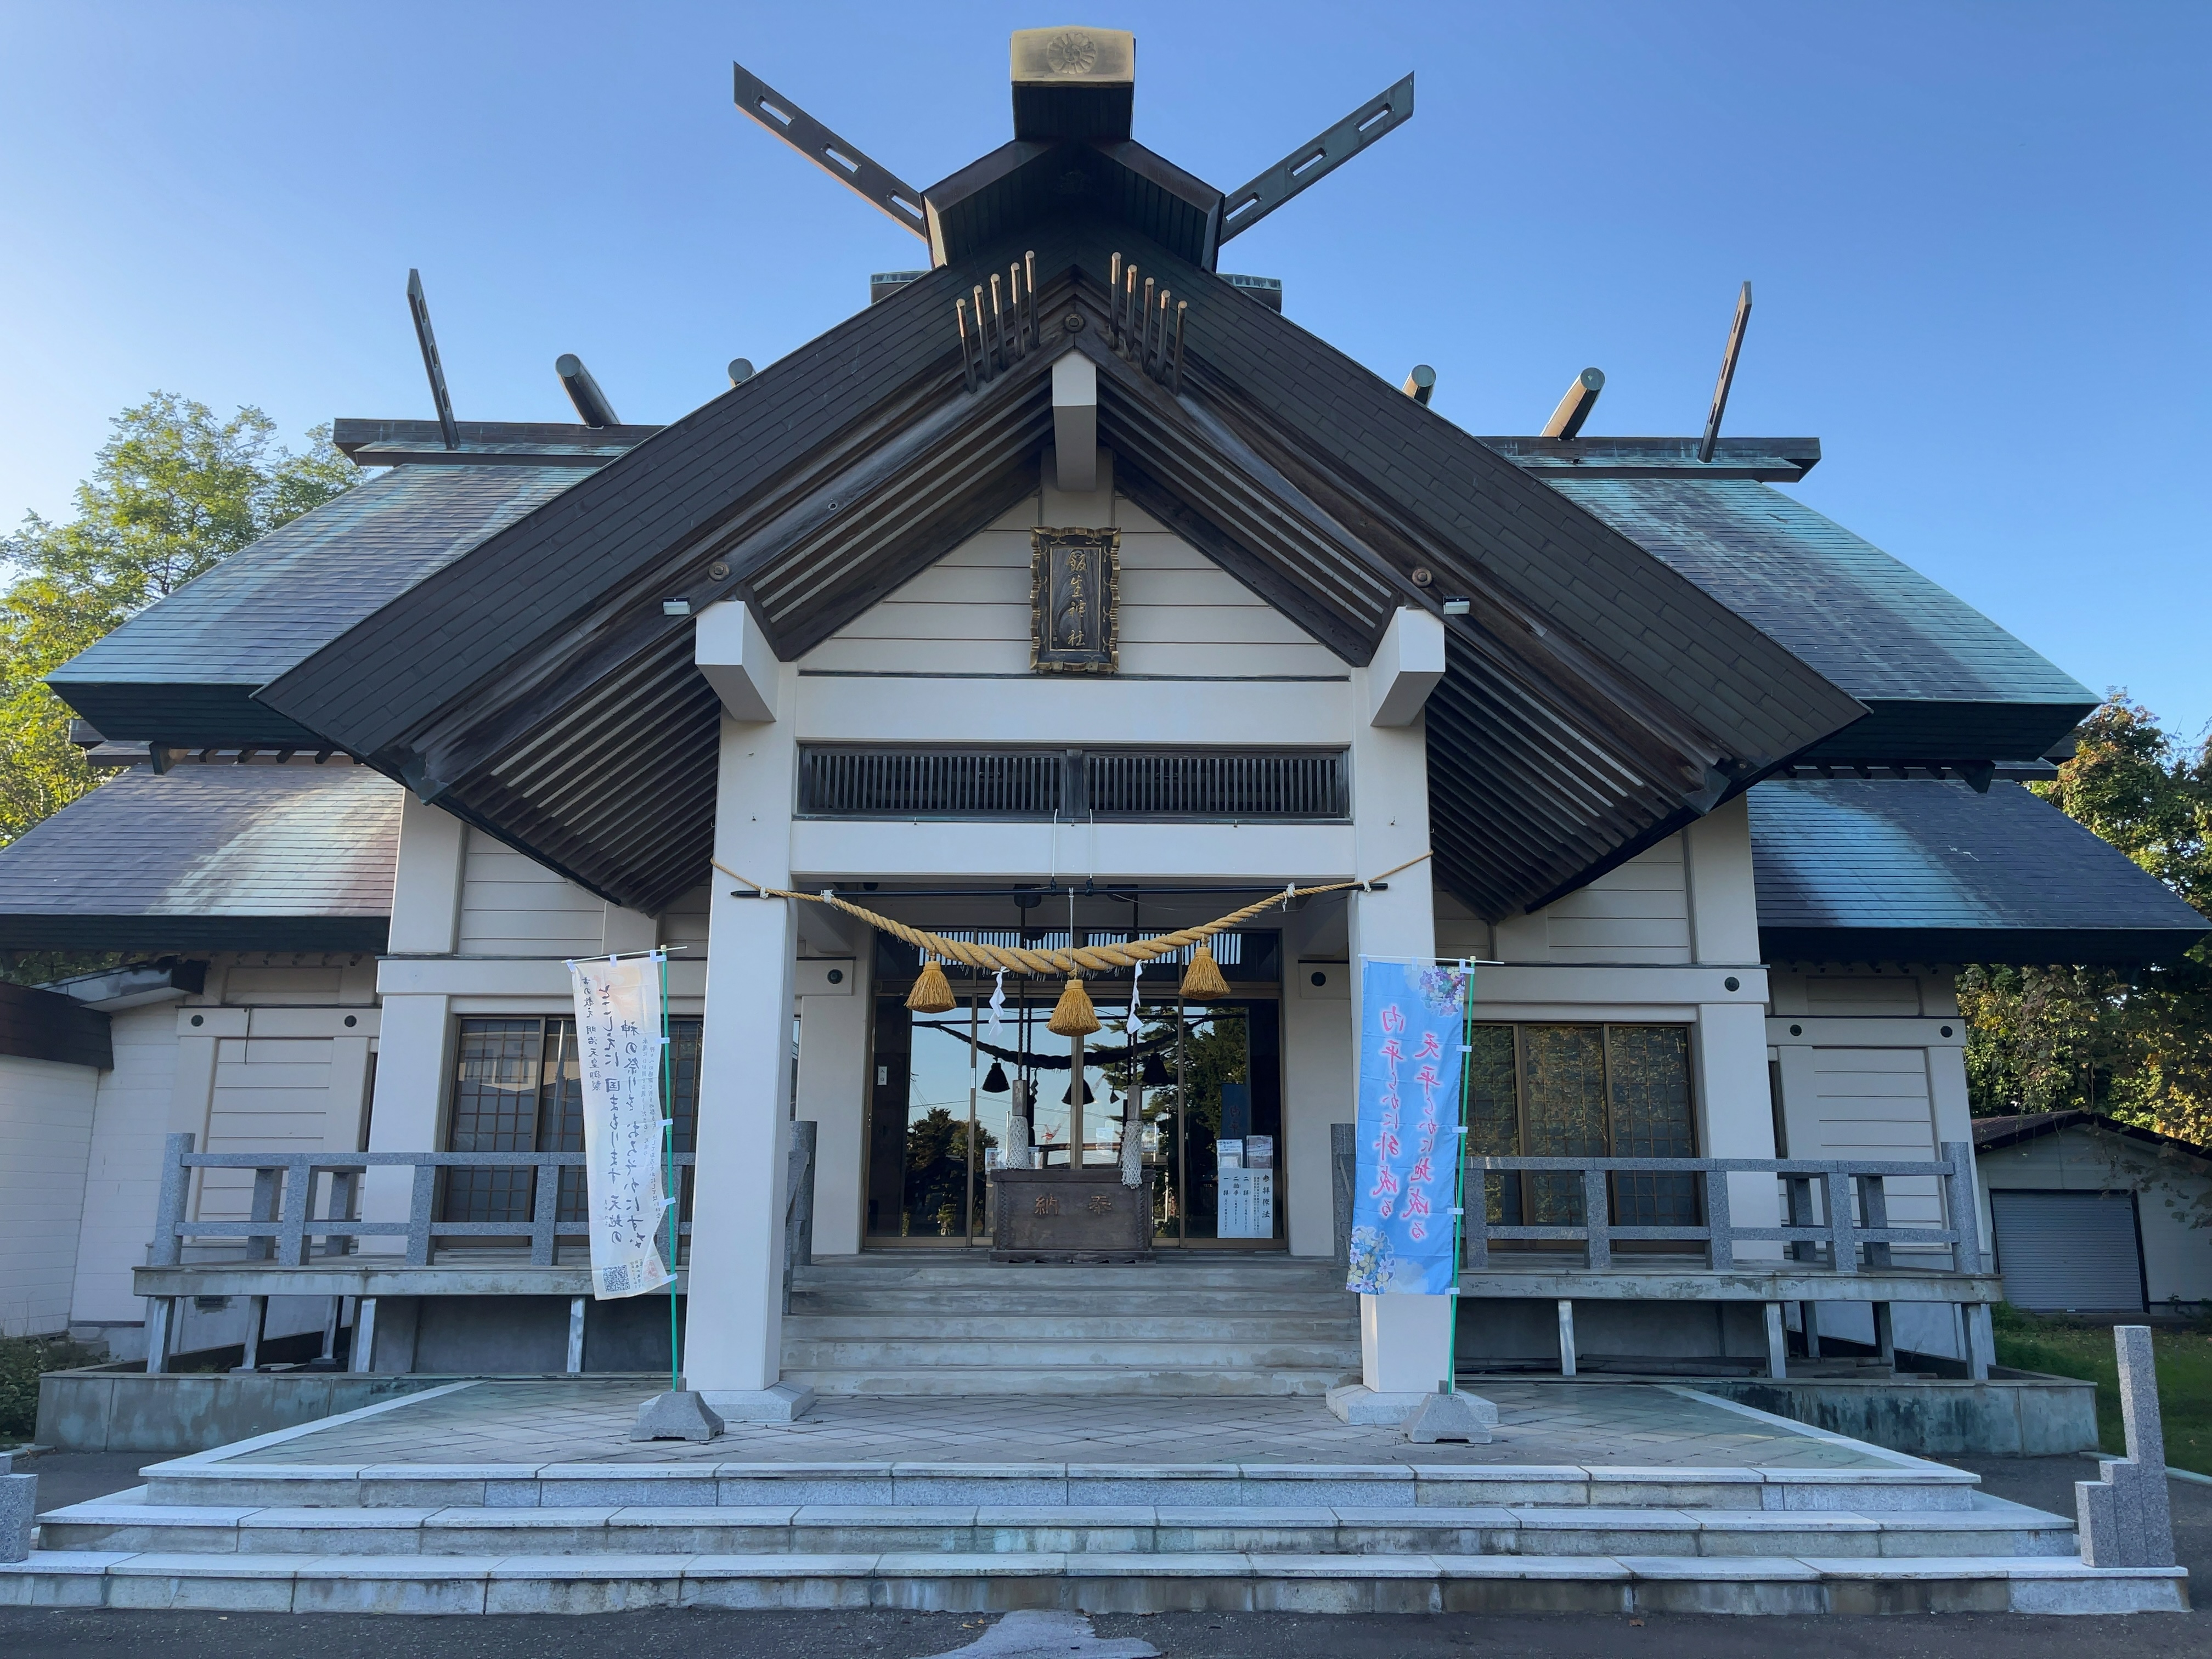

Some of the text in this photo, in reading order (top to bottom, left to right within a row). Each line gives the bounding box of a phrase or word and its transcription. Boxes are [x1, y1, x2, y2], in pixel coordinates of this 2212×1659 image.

[1065, 550, 1087, 647] 飯生神社
[879, 1069, 885, 1081] 入口
[1262, 1174, 1270, 1218] 参拝作法
